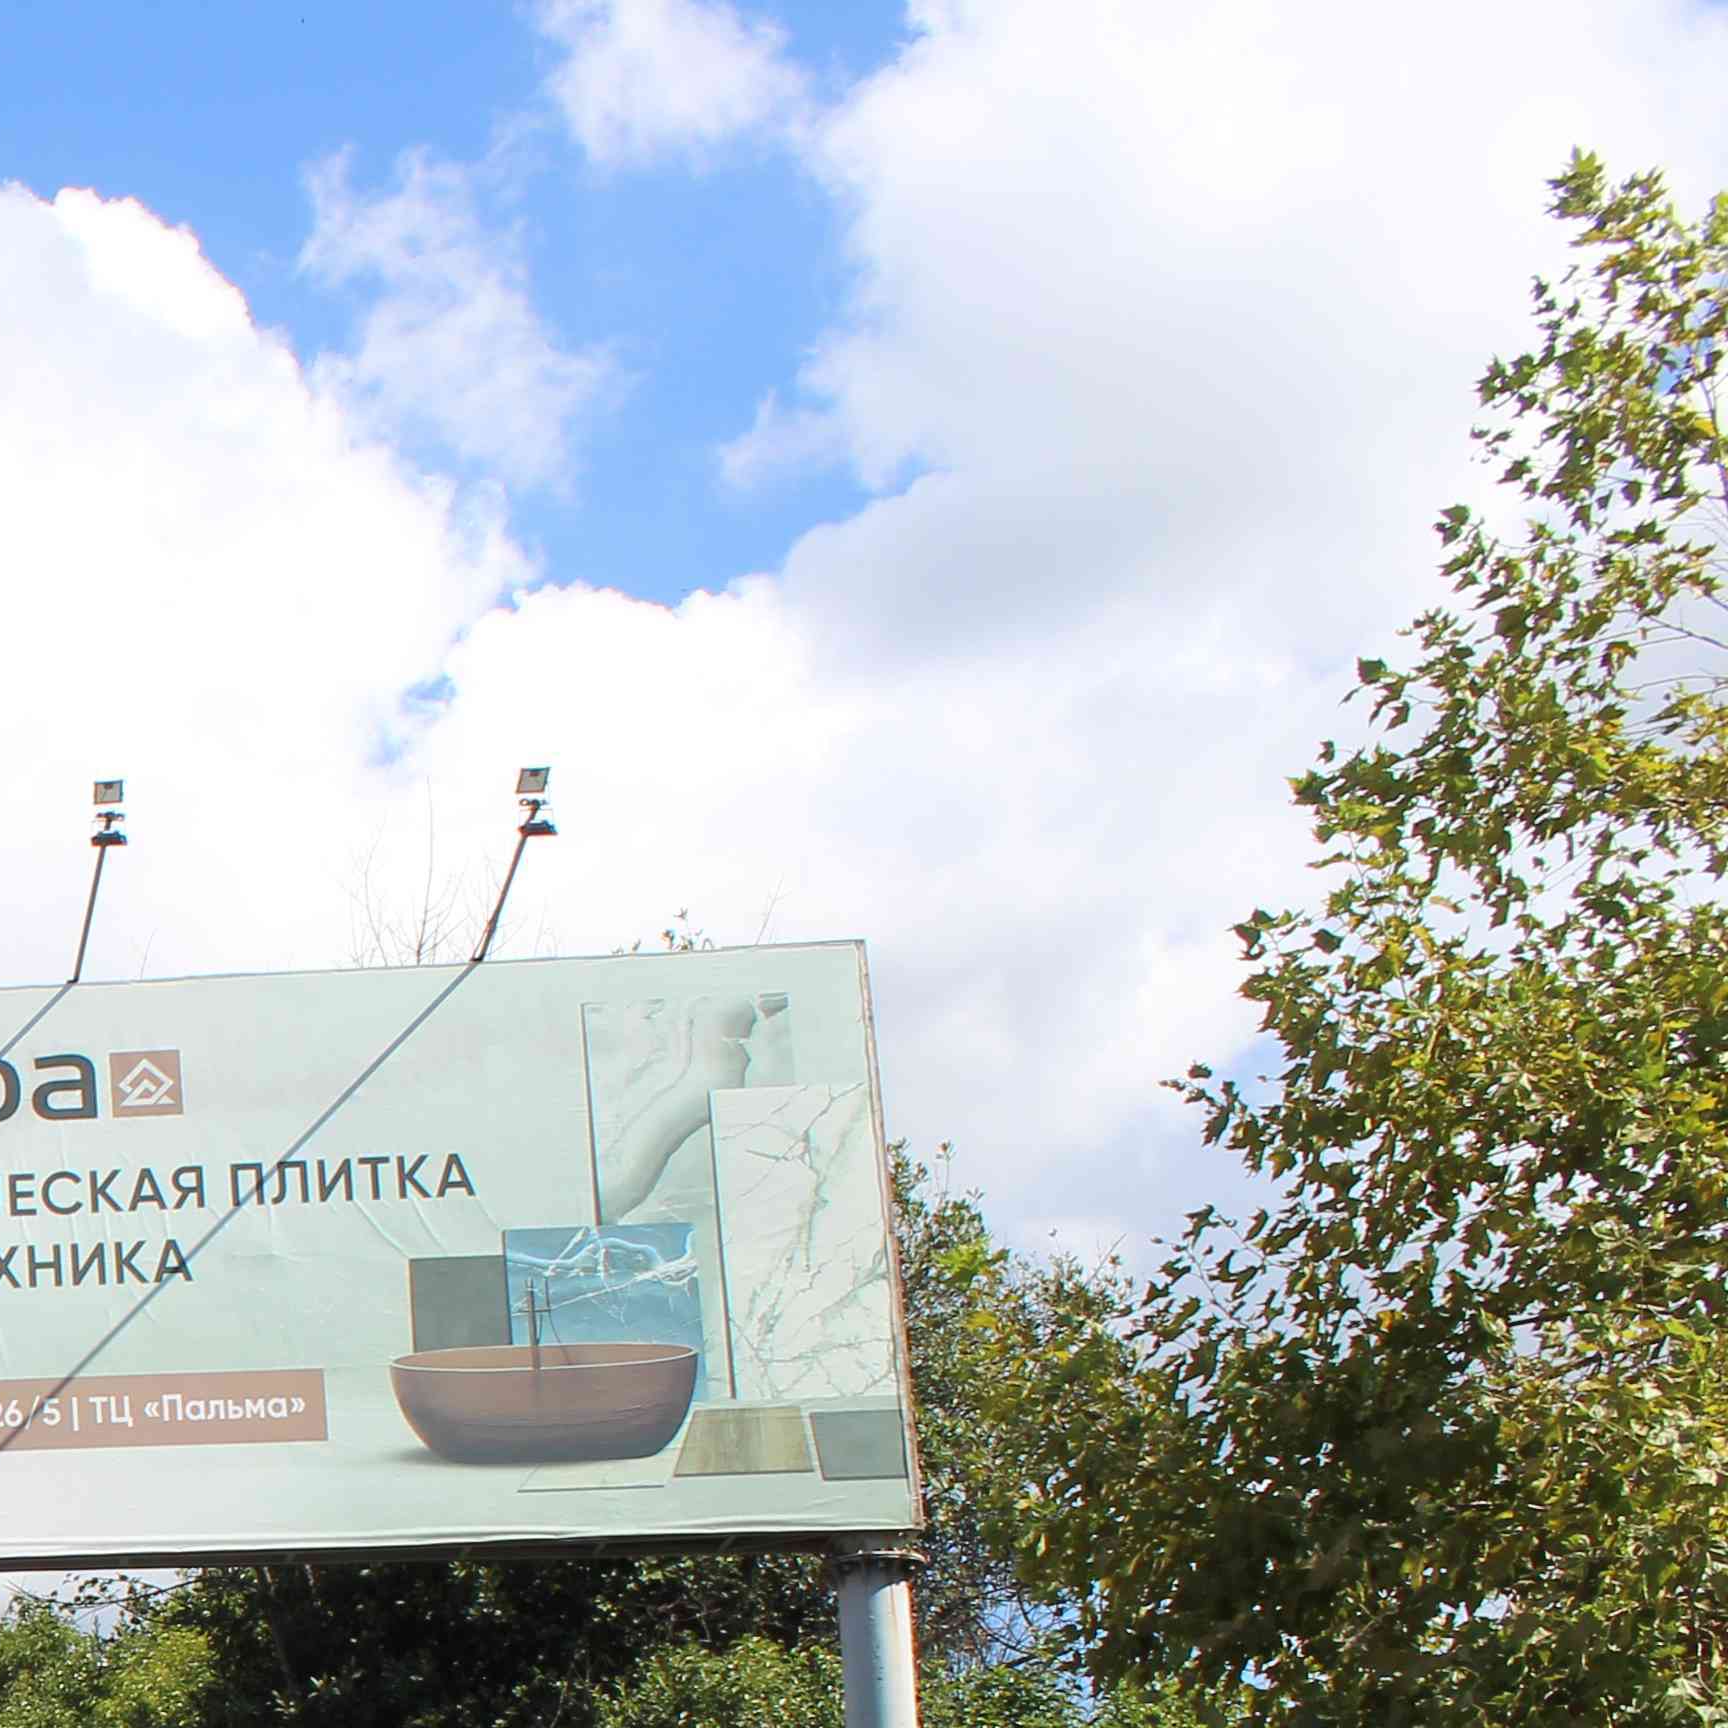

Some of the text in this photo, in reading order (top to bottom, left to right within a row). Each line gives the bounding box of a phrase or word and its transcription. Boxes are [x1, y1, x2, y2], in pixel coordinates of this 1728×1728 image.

[229, 1152, 476, 1208] ПЛИТКА
[88, 1395, 134, 1428] ТЦ
[143, 1393, 306, 1422] «Пальма»
